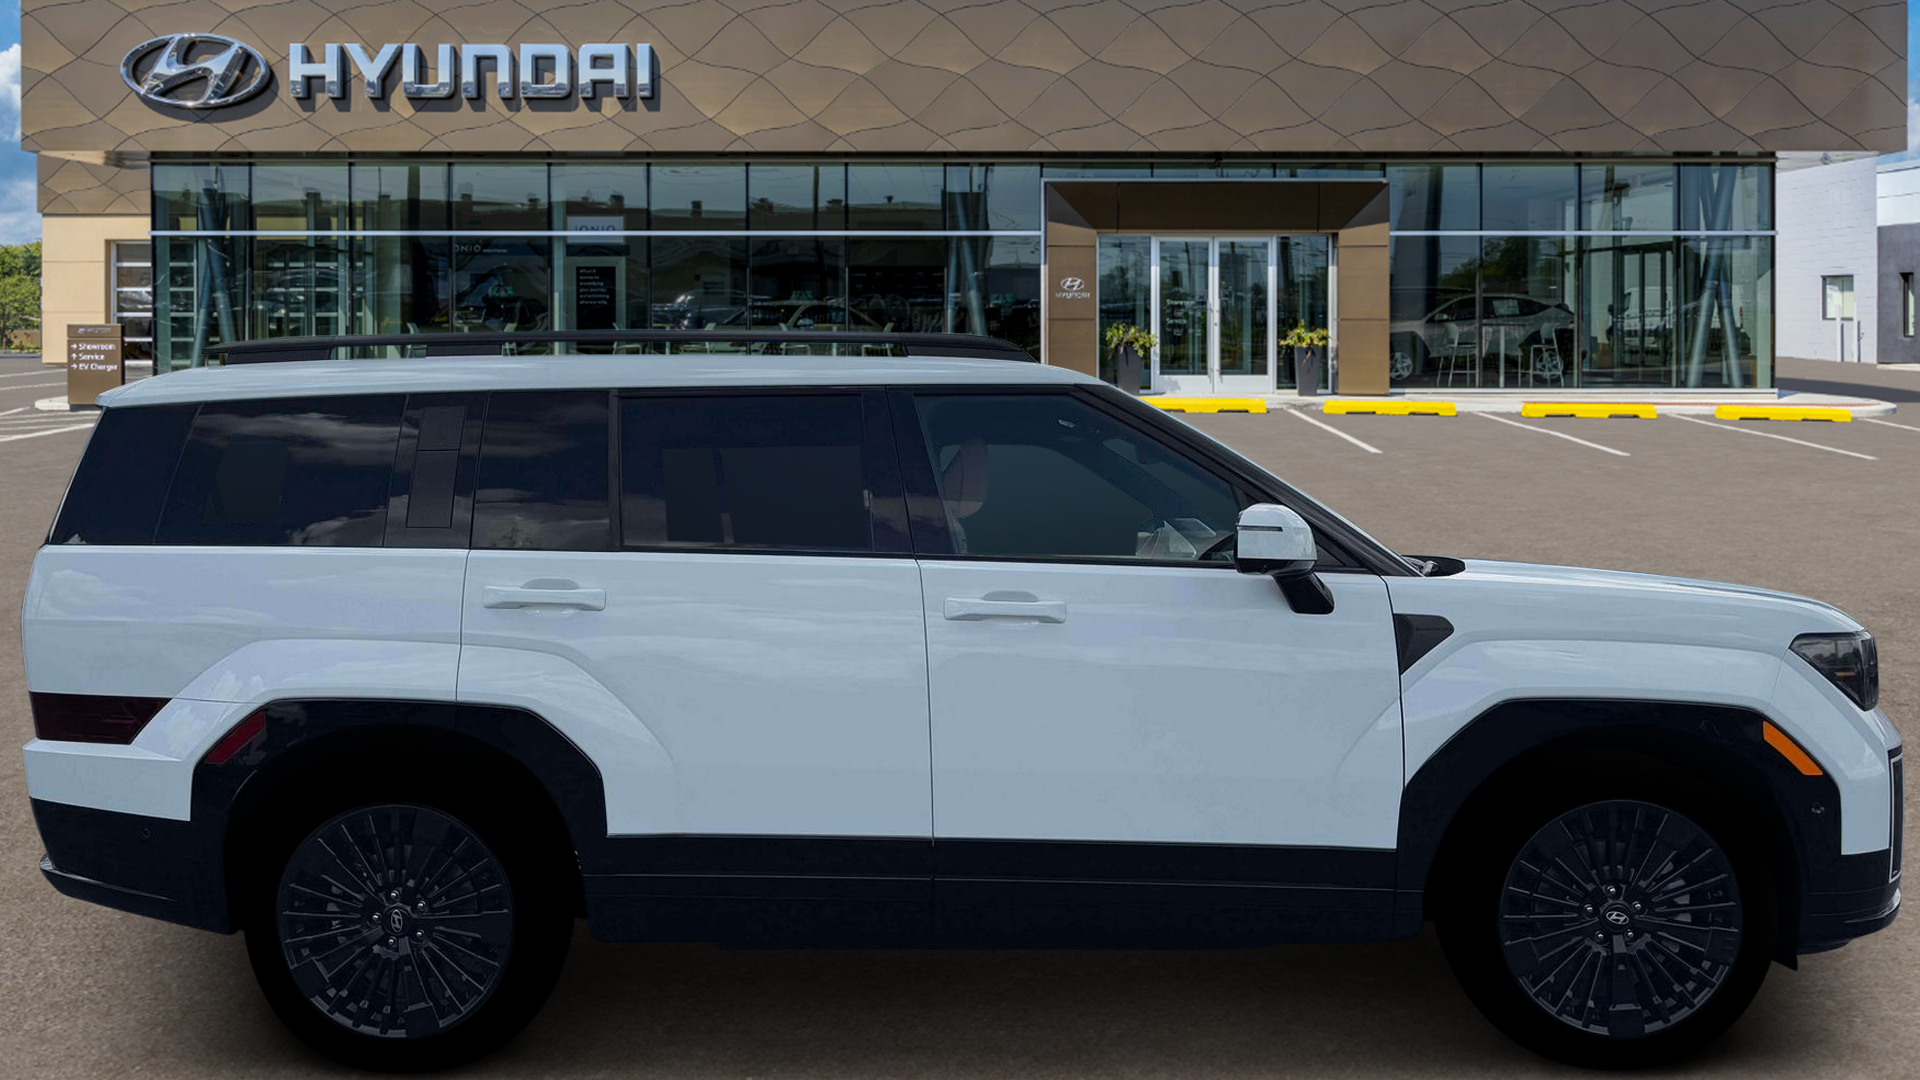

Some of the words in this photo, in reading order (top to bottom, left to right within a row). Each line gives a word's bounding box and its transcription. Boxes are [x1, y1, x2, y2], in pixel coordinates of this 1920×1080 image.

[289, 43, 654, 99] HYUNDAI
[79, 352, 105, 360] Service
[90, 363, 118, 372] Charger
